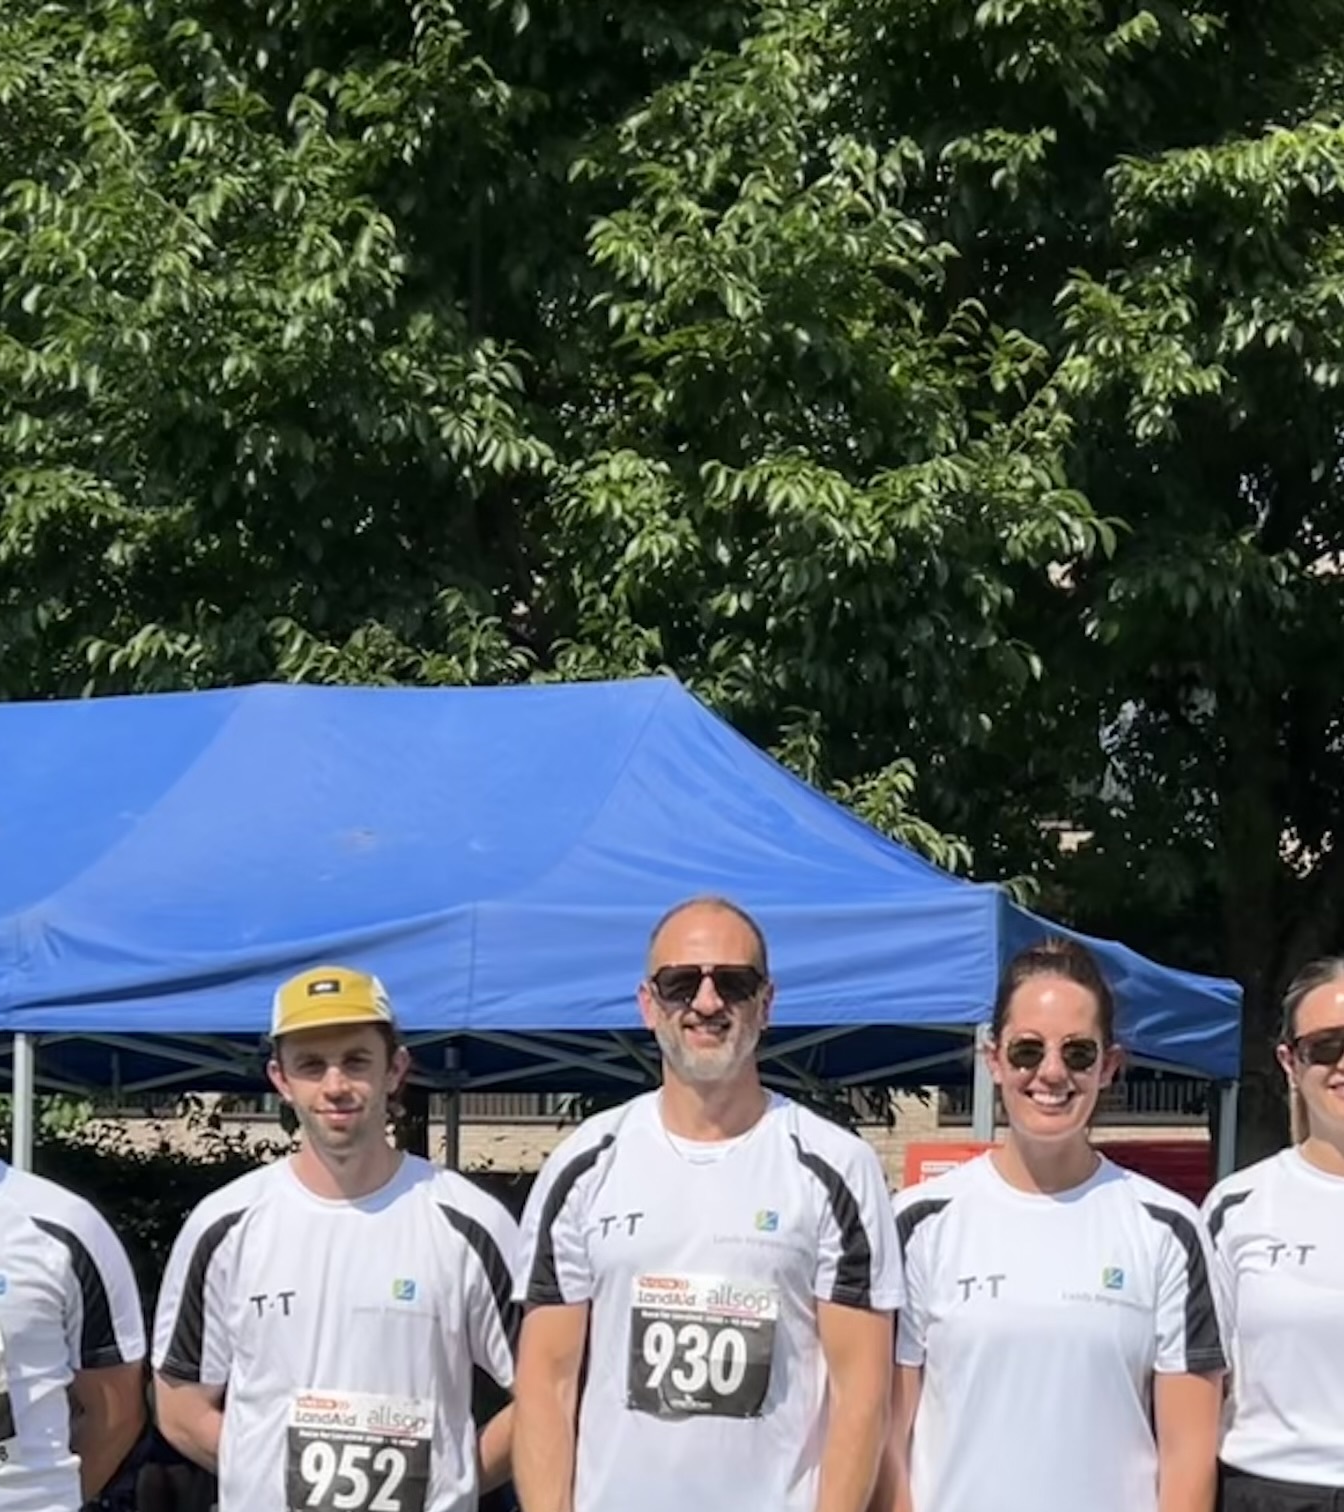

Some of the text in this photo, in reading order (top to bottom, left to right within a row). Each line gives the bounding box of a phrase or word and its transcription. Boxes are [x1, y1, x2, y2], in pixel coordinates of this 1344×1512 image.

[706, 1284, 770, 1312] allsop
[642, 1321, 748, 1396] 930
[367, 1405, 428, 1433] allsop
